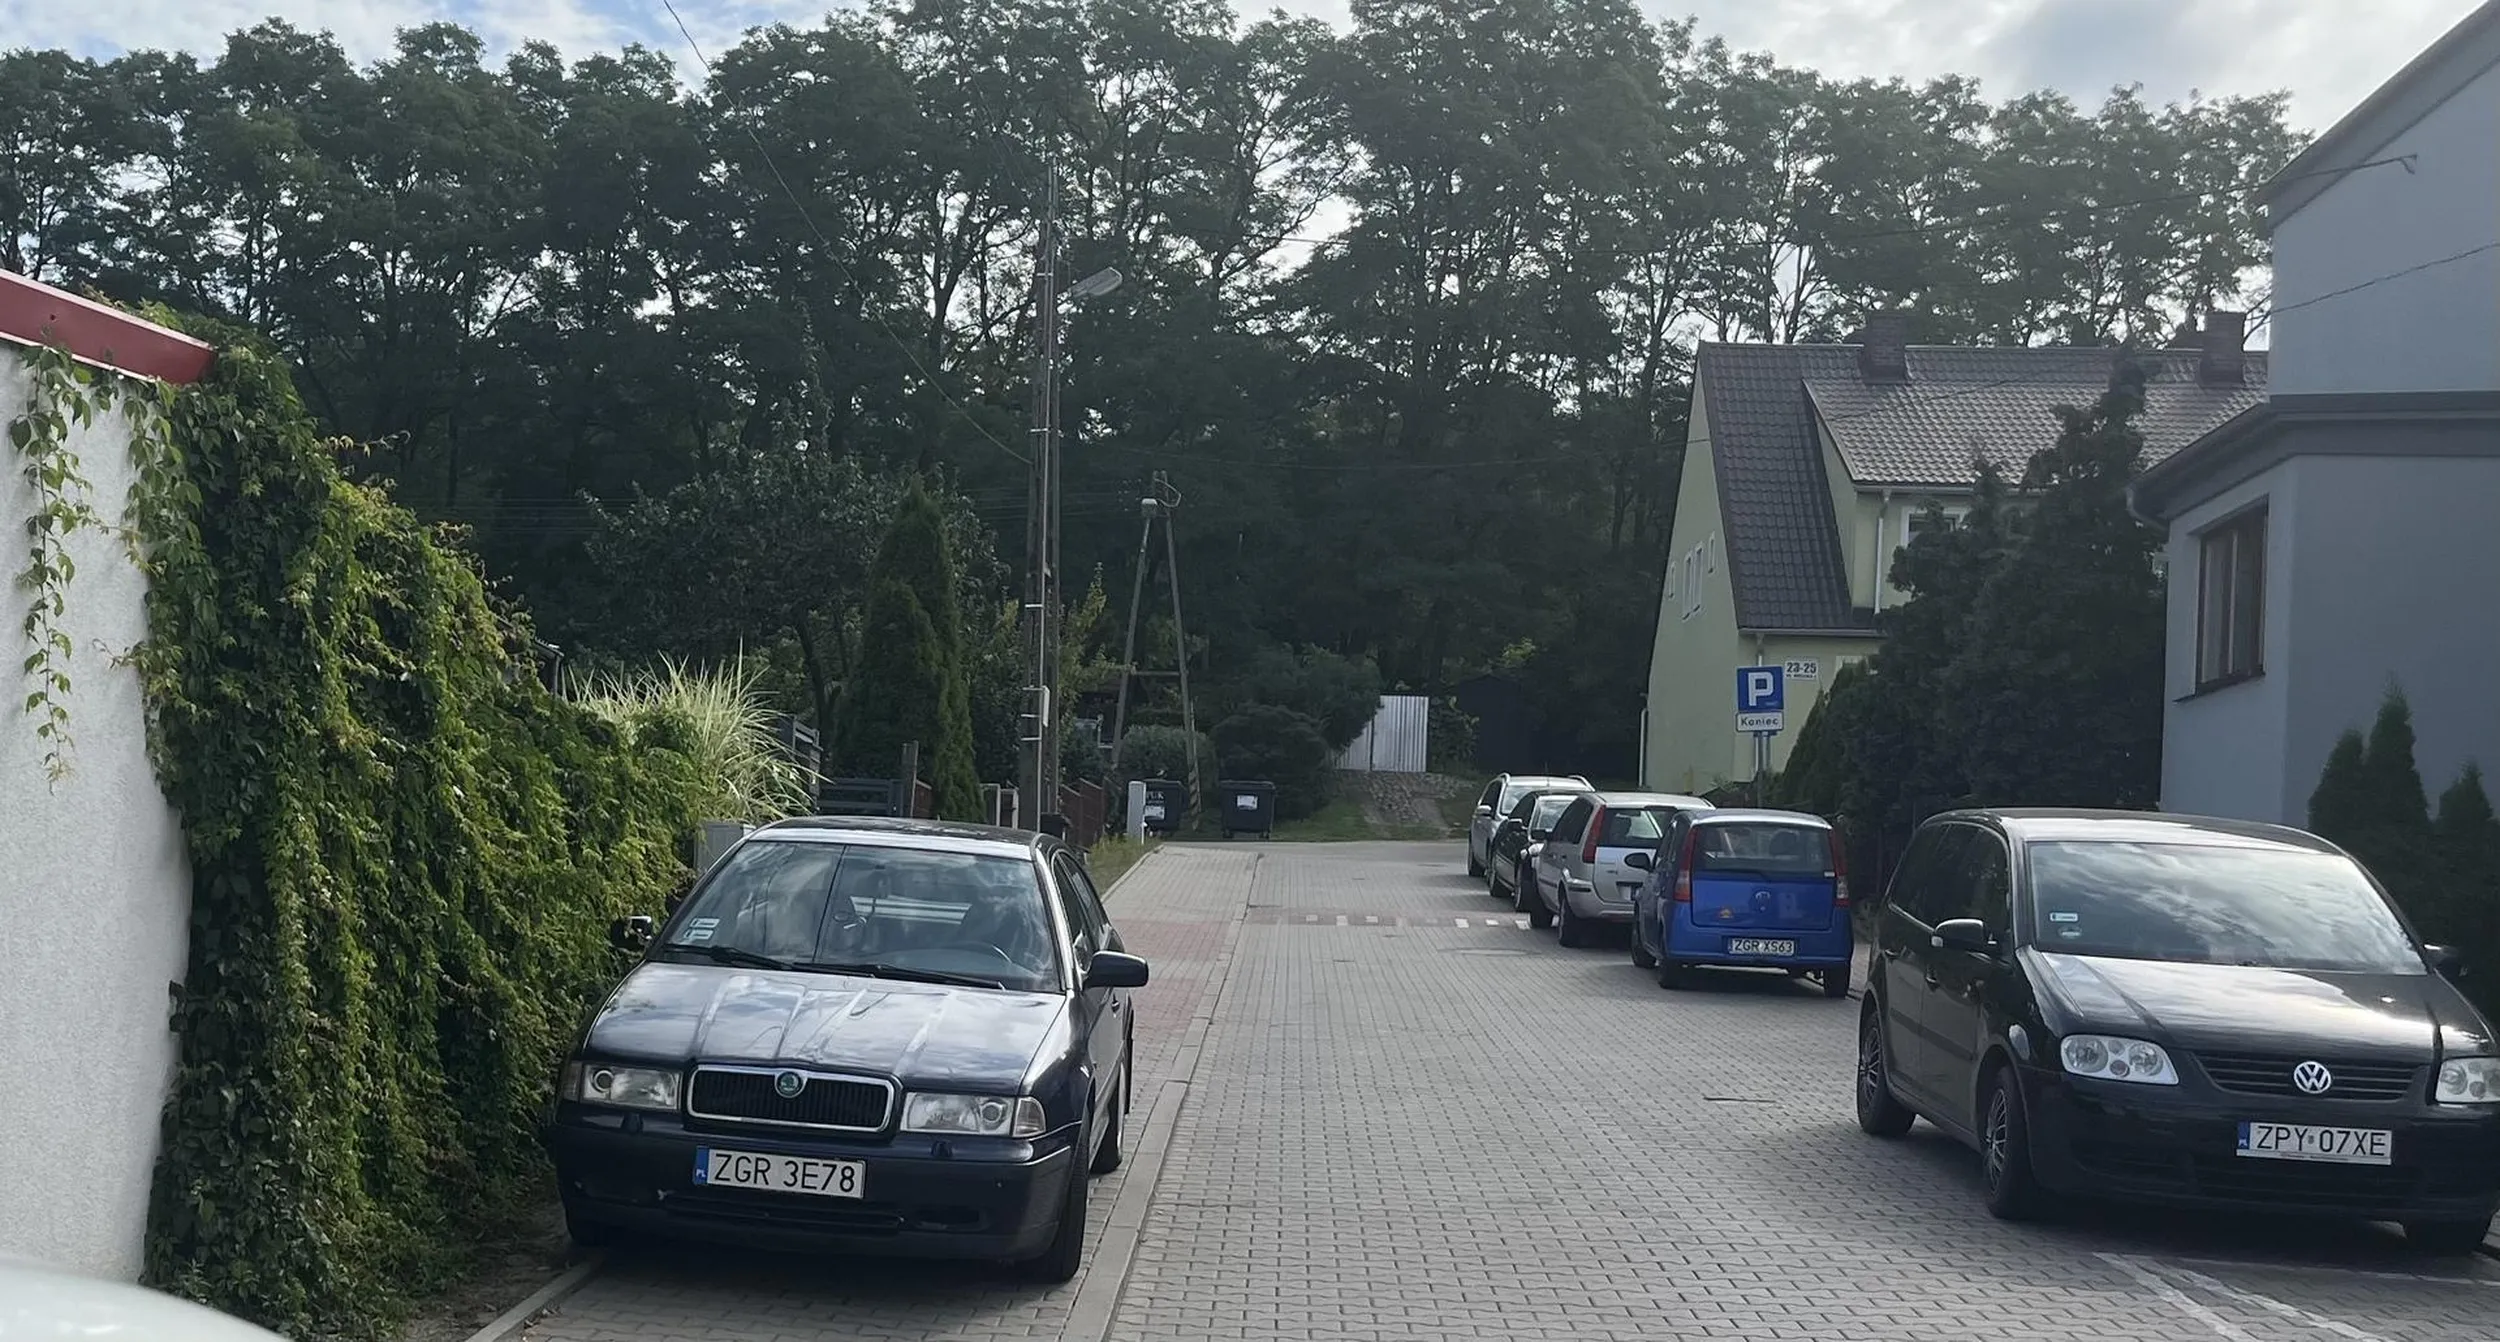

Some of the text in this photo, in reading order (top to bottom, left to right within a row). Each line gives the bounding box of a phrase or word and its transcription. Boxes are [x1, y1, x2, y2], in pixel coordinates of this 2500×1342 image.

[1786, 662, 1817, 674] 23-25
[1748, 671, 1774, 706] P
[1741, 717, 1779, 726] Koniec
[1734, 939, 1760, 952] ZGR
[2257, 1125, 2386, 1156] ZPY 07XE
[714, 1153, 855, 1192] ZGR 3E78
